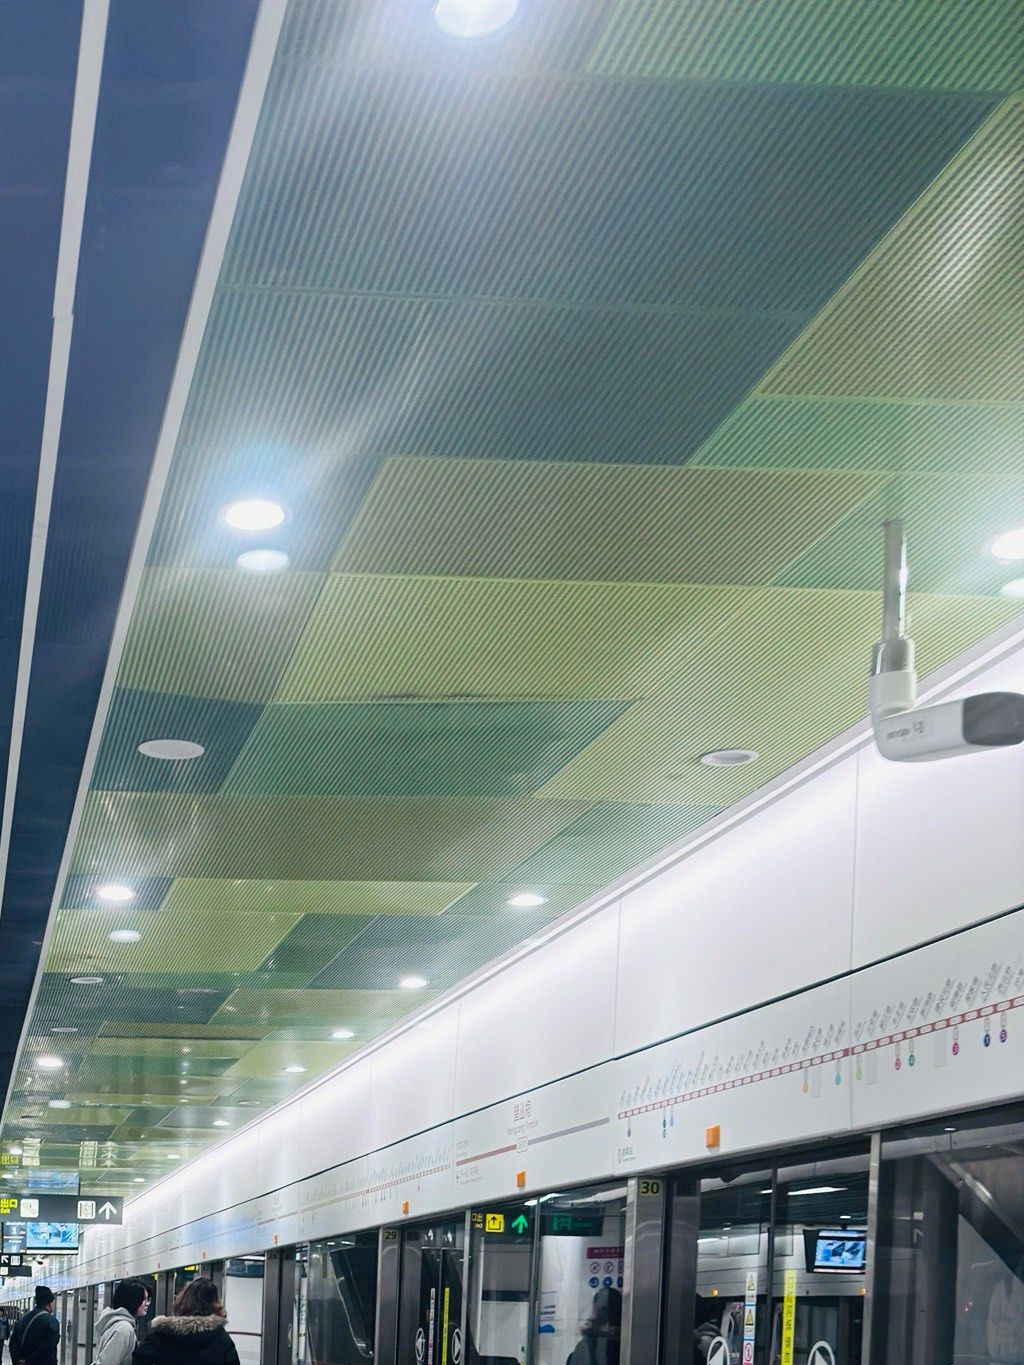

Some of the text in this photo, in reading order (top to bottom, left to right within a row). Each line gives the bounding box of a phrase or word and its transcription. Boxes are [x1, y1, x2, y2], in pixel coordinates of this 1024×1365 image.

[640, 1180, 660, 1195] 30
[0, 1198, 18, 1208] 出口
[385, 1231, 397, 1240] 29
